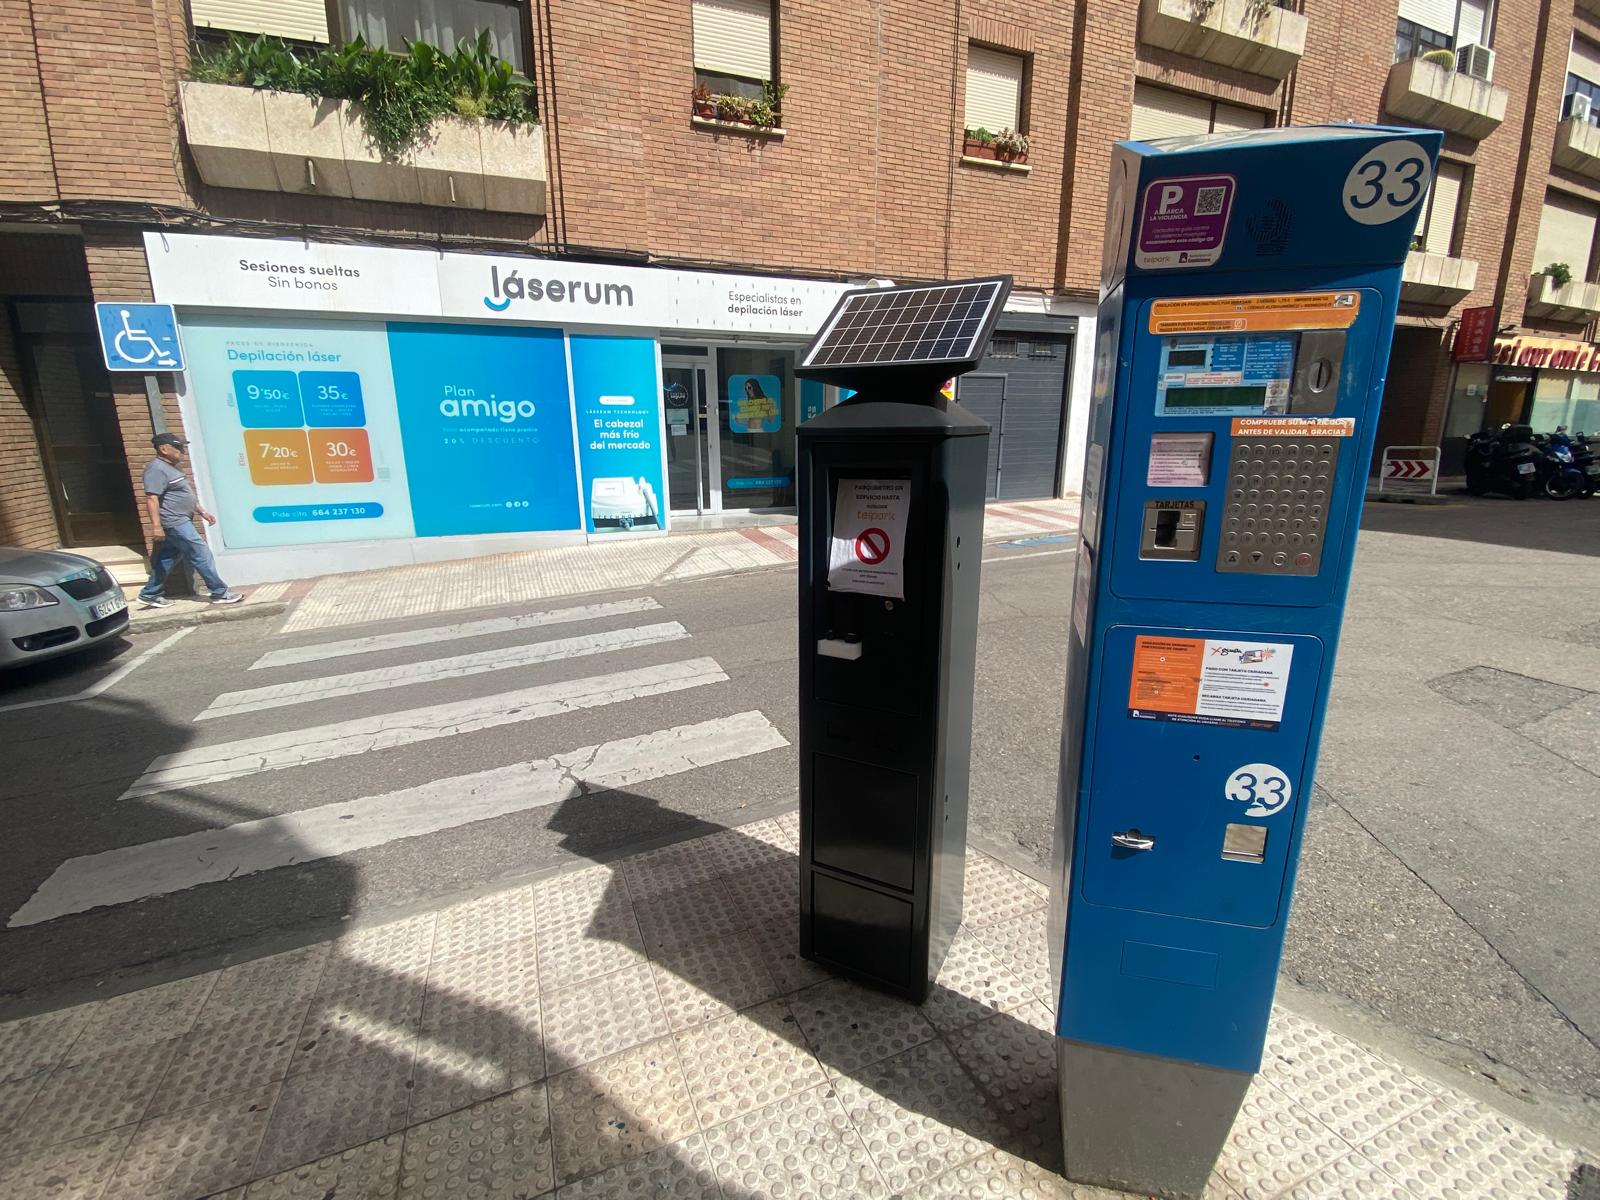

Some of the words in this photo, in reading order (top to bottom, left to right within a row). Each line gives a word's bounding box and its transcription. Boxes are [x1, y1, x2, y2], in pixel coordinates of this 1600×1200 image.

[1350, 157, 1425, 209] 33
[239, 259, 305, 275] Sesiones
[309, 264, 360, 278] sueltas
[268, 276, 291, 289] Sin
[294, 277, 338, 291] bonos
[491, 265, 634, 307] láserum
[728, 290, 788, 305] Especialistas
[790, 297, 802, 306] en
[727, 304, 778, 317] depilación
[779, 306, 804, 318] láser
[227, 349, 304, 363] Depilación
[307, 350, 342, 362] láser
[316, 385, 349, 400] 35€
[444, 384, 475, 397] Plan
[440, 393, 536, 423] amigo
[593, 418, 603, 428] El
[605, 418, 644, 428] cabezal
[599, 430, 620, 439] más
[622, 429, 640, 439] frío
[326, 442, 357, 457] 30€
[590, 440, 605, 450] del
[607, 440, 651, 450] mercado
[311, 508, 330, 517] 664
[332, 507, 349, 516] 237
[350, 507, 366, 515] 130
[1154, 500, 1195, 509] TARJETAS
[1231, 772, 1286, 811] 33
